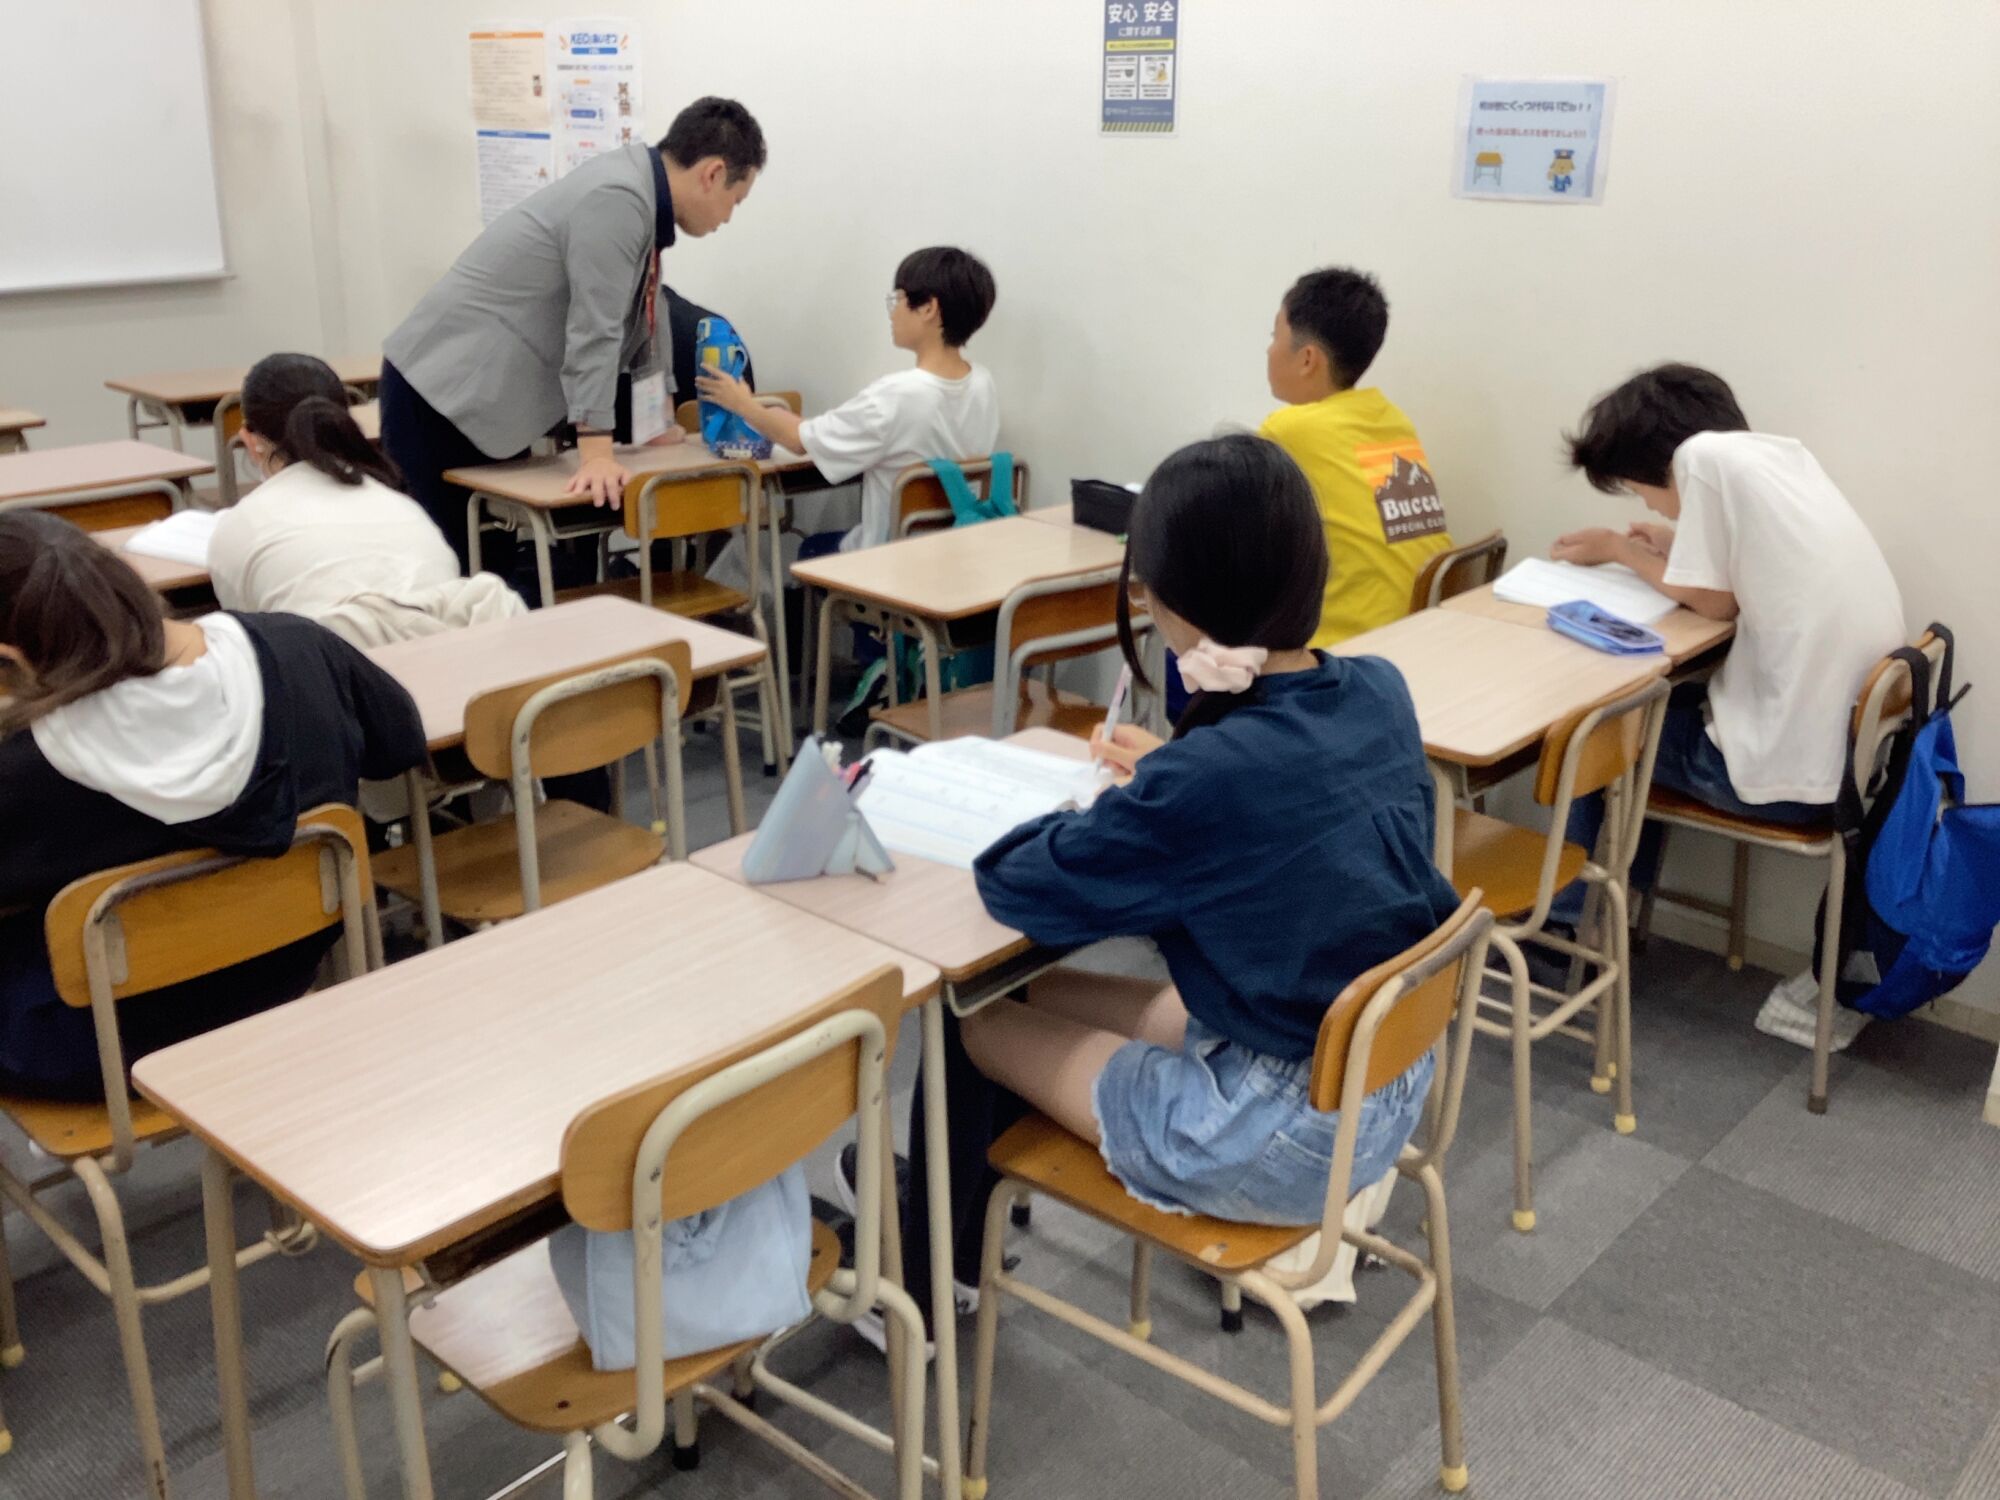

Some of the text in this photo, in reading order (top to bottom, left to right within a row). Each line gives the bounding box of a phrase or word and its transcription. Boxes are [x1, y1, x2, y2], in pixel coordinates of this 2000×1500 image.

[1108, 1, 1175, 24] 安心 安全
[1381, 495, 1443, 520] Bucca
[1387, 521, 1425, 537] SPECIAL
